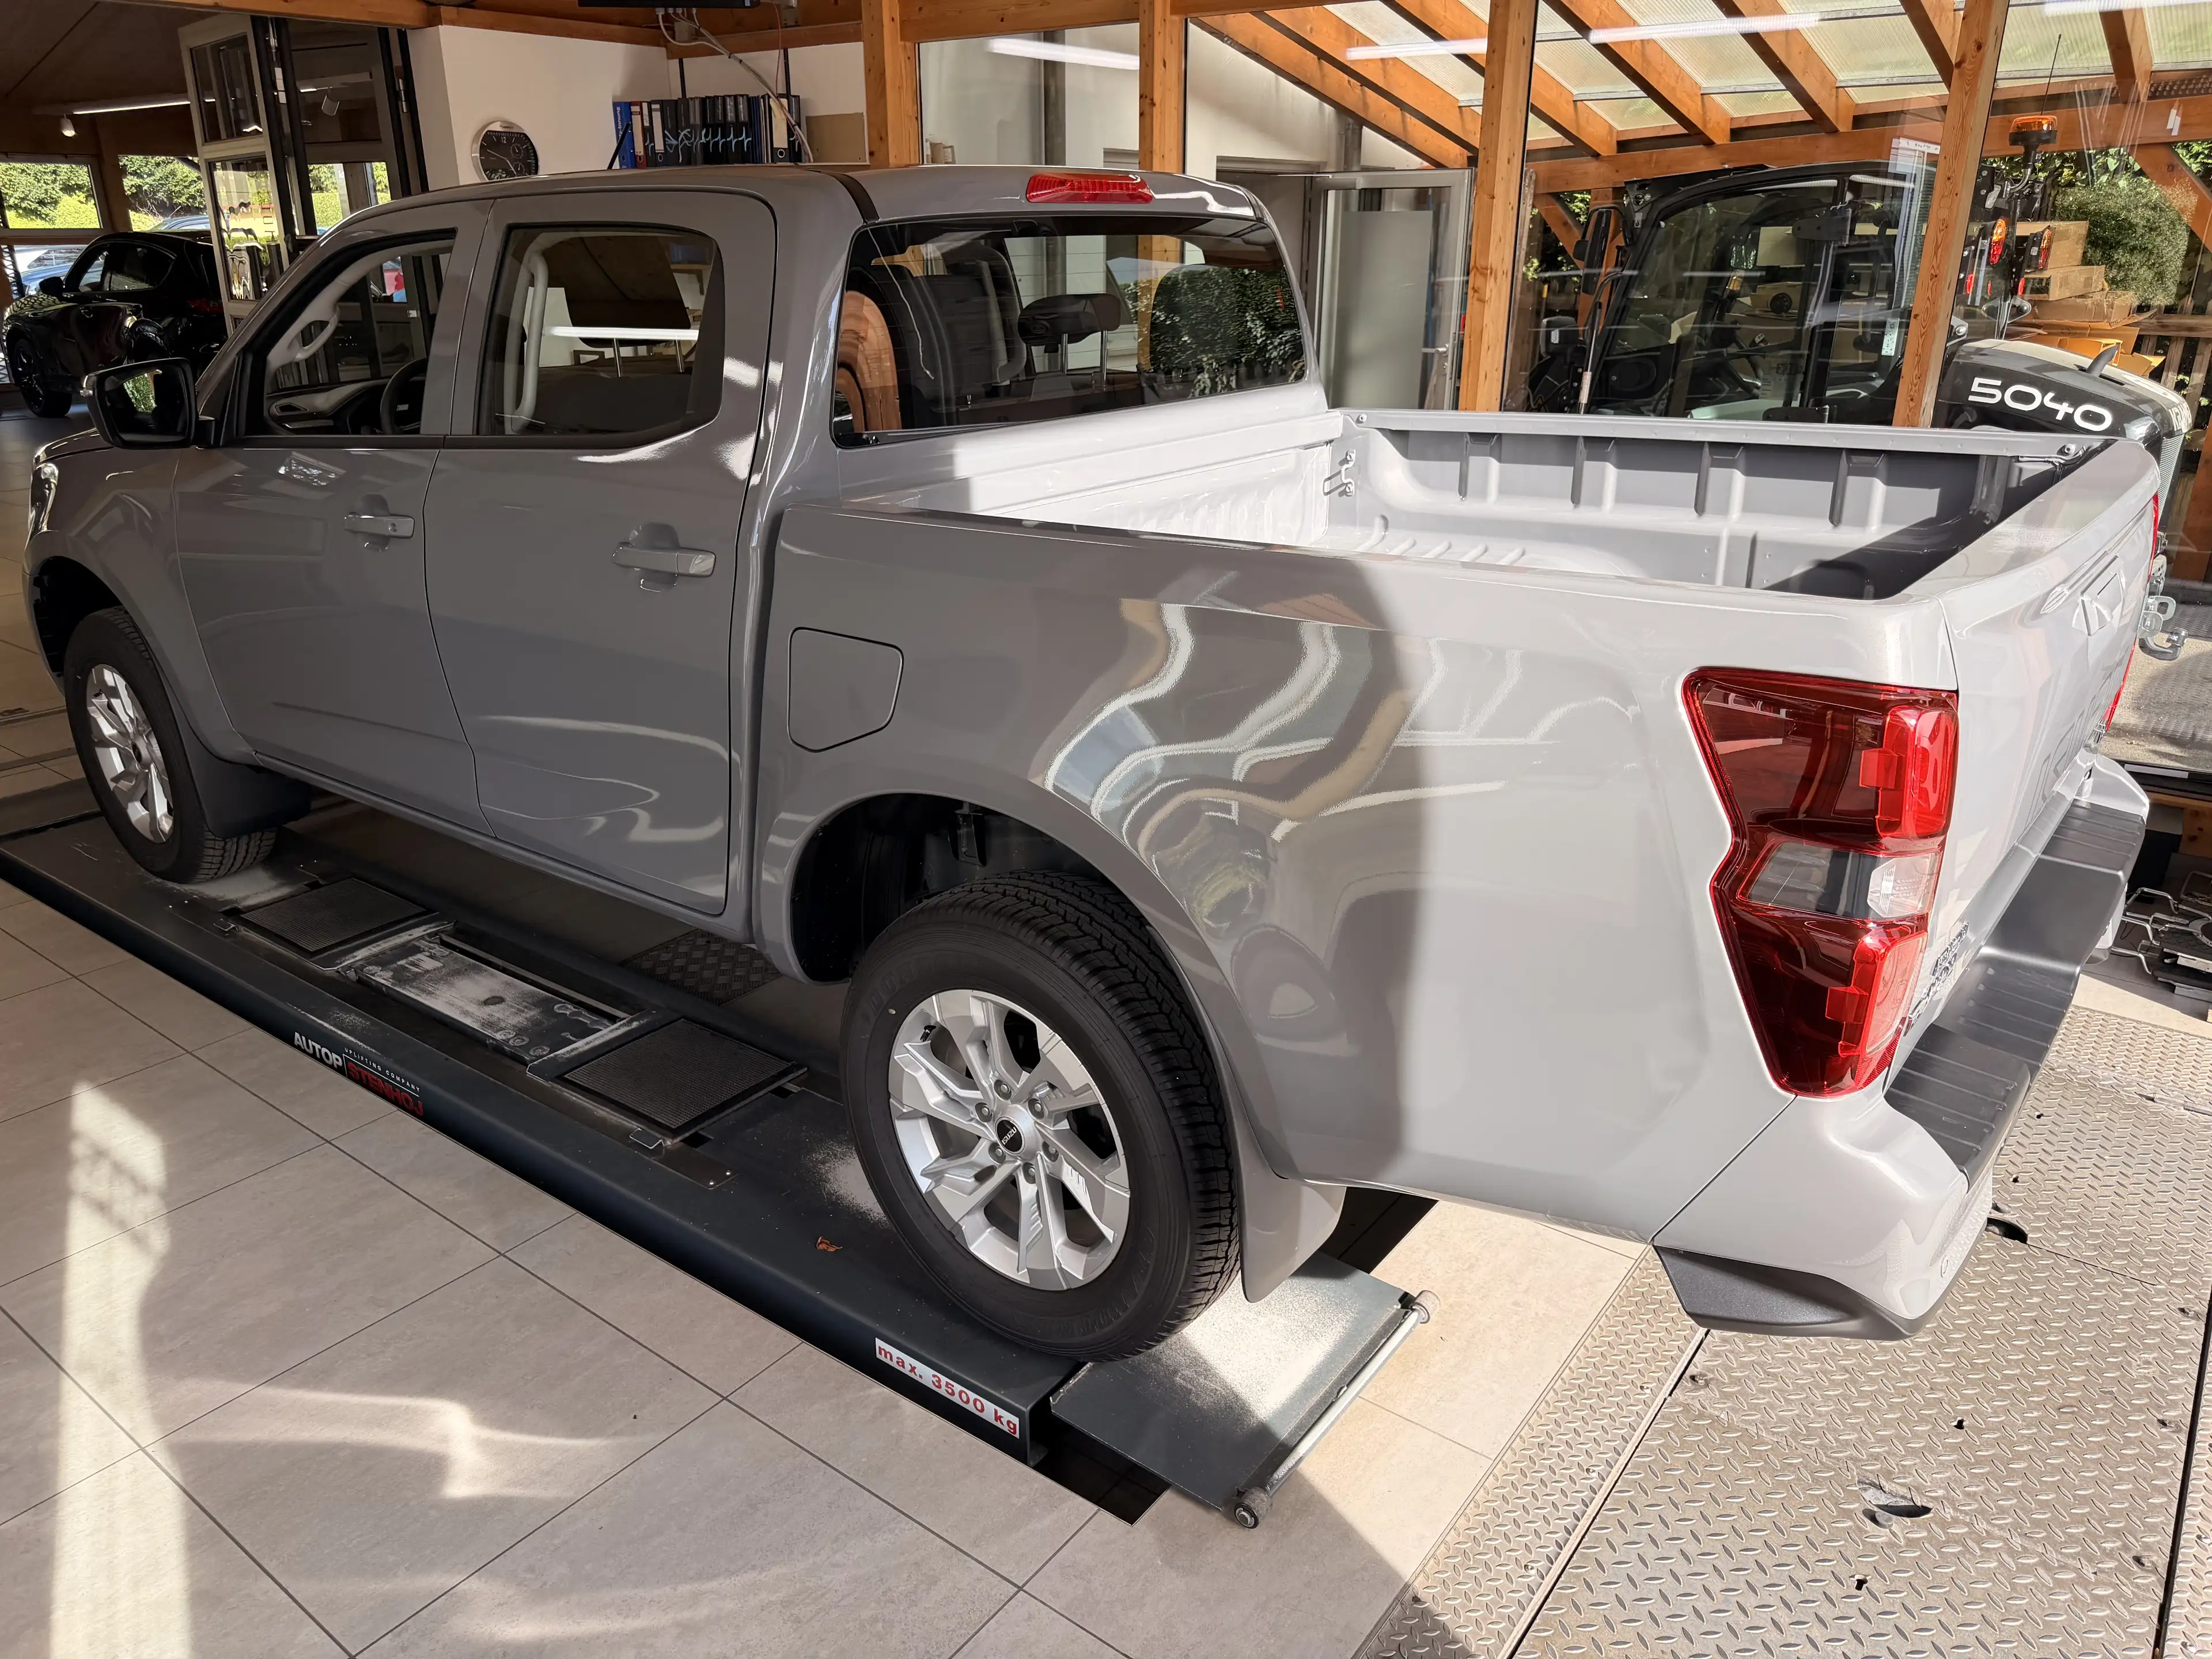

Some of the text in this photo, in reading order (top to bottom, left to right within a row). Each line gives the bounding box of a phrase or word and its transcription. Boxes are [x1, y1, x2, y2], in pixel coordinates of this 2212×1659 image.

[1968, 377, 2112, 431] 5040
[294, 1032, 343, 1069] AUTOP
[344, 1047, 420, 1092] UPLIFTING COMPANY
[1002, 1127, 1017, 1145] ISUZU
[878, 1345, 1017, 1435] max. 3500 kg
